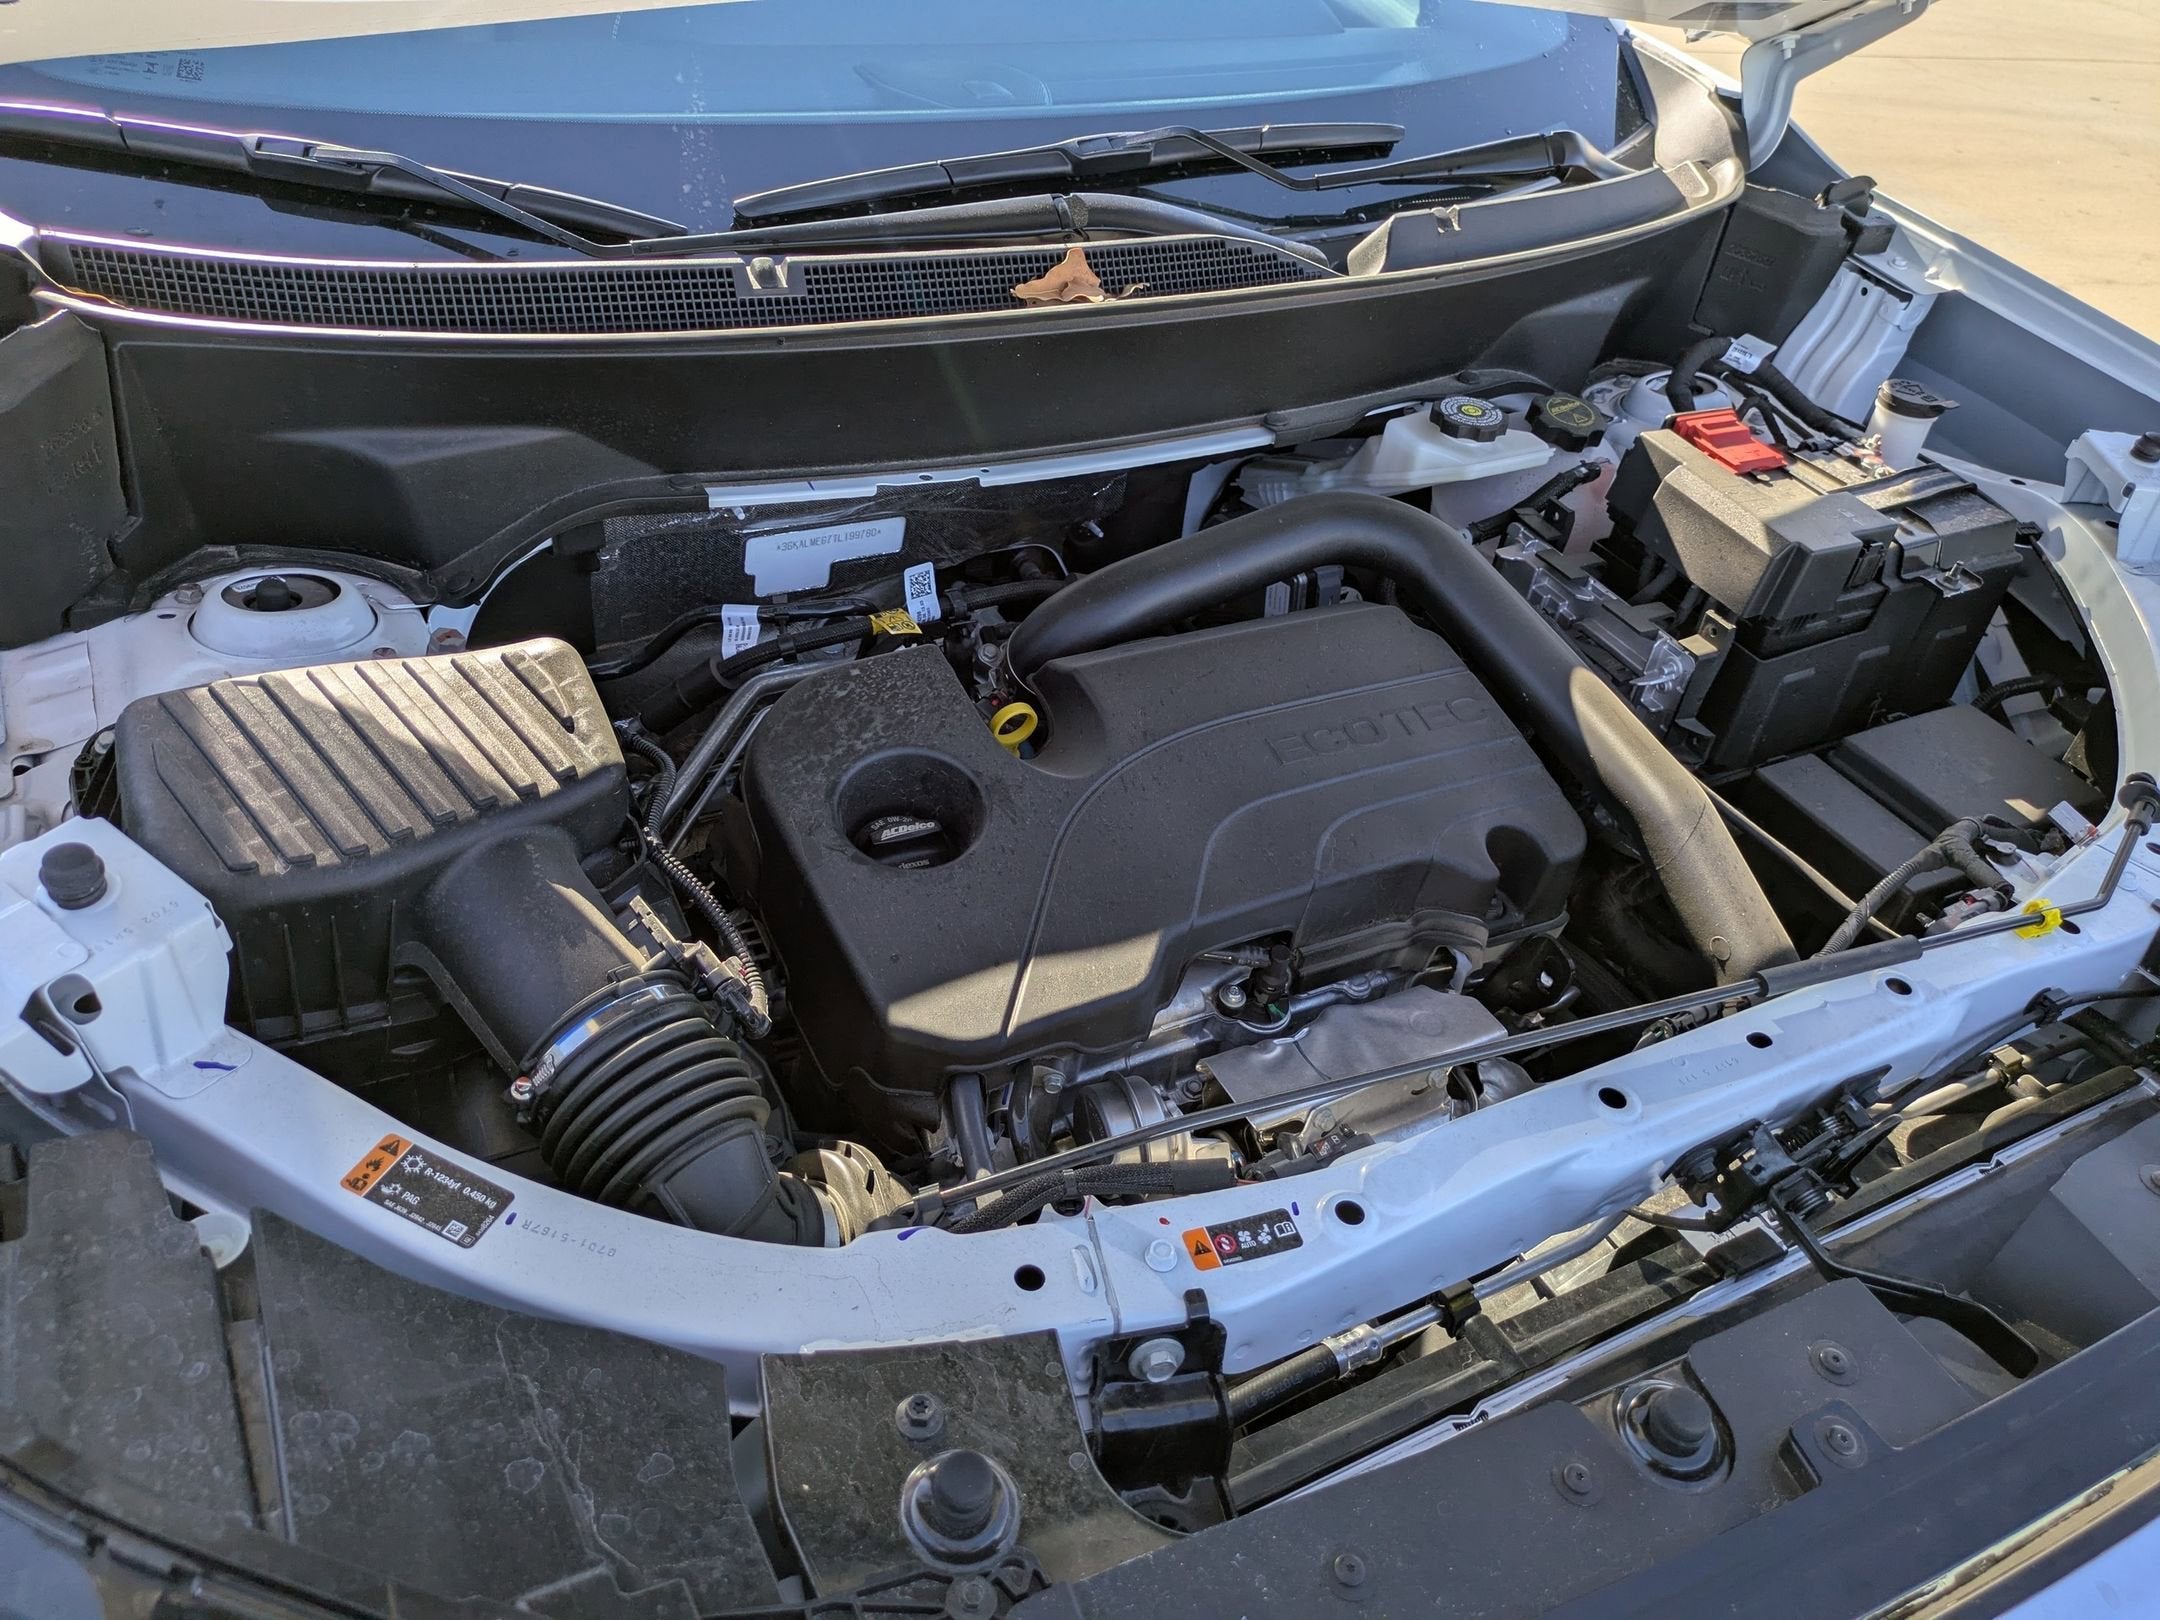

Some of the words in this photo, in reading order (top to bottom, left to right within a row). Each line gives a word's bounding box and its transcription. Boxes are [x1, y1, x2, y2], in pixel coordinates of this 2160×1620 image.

[1264, 697, 1490, 768] ECOTEC
[871, 820, 886, 831] SAE
[881, 821, 935, 838] ACDelco
[424, 1167, 461, 1189] R-1234yf
[462, 1186, 487, 1203] 0.450
[485, 1197, 497, 1210] kg
[401, 1191, 420, 1205] PAG
[1240, 1239, 1257, 1250] AUTO
